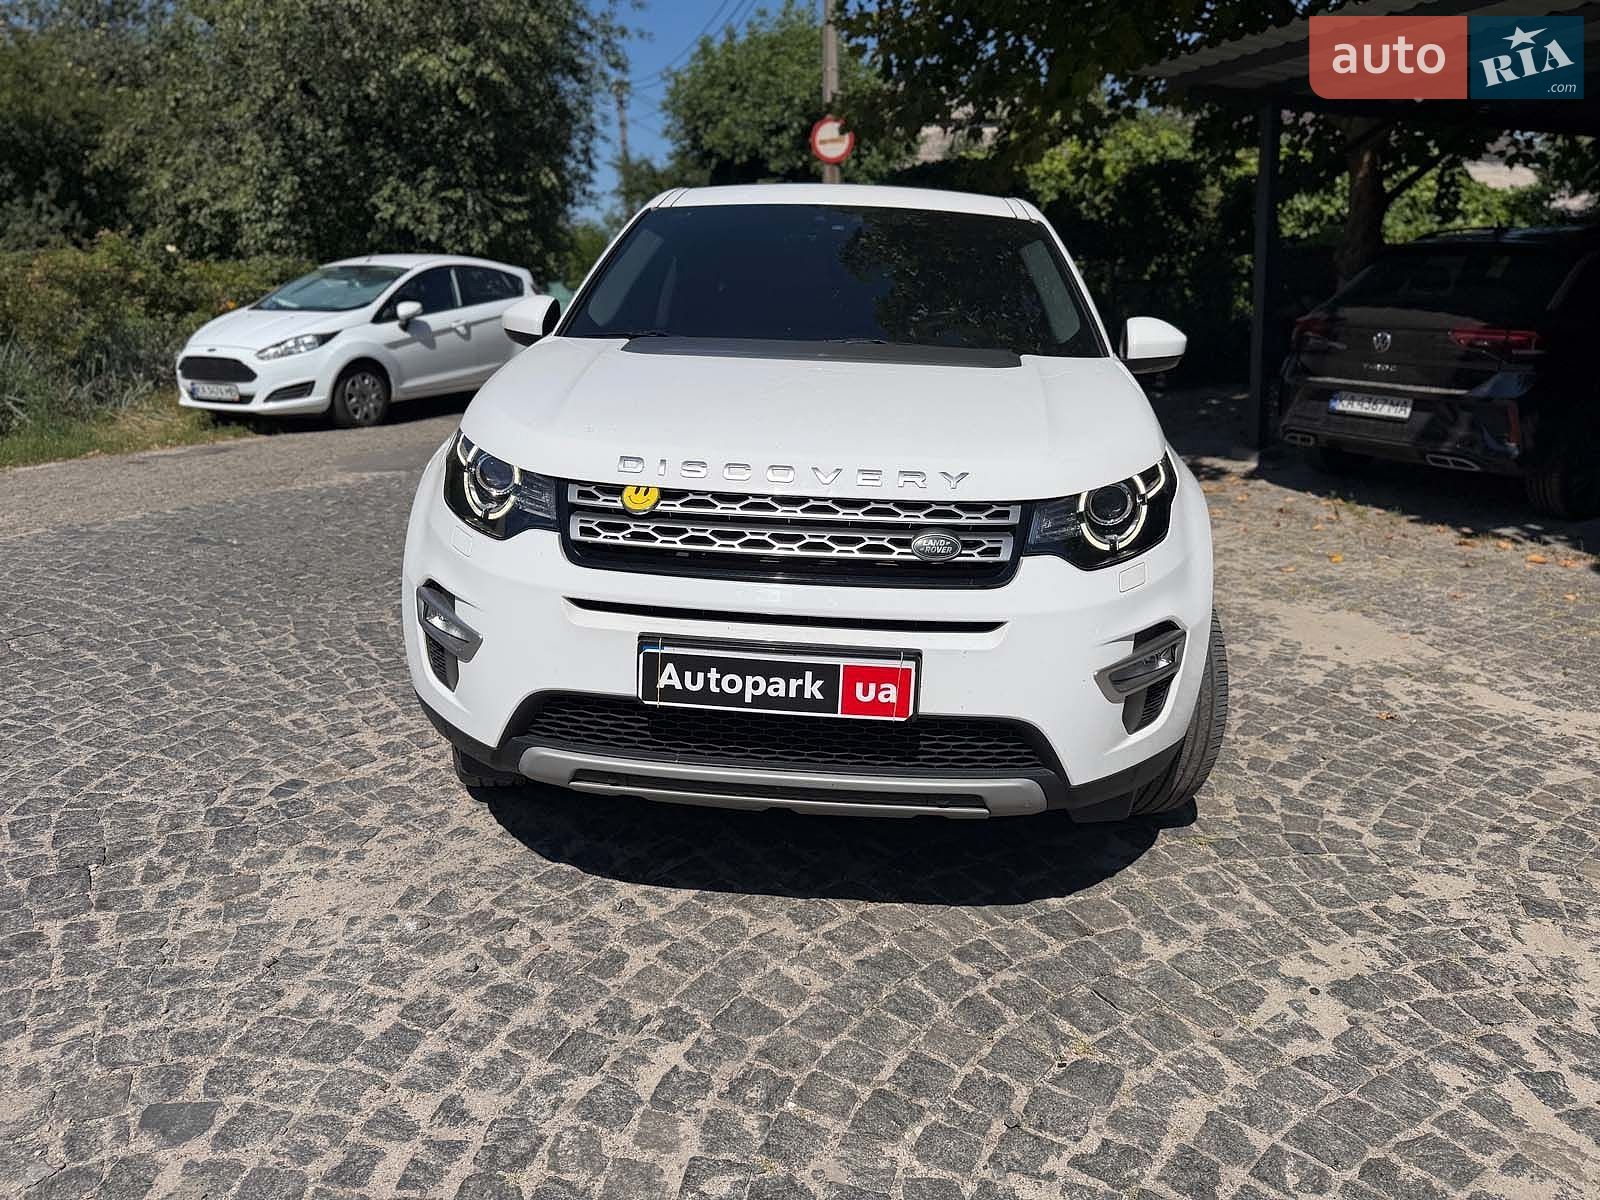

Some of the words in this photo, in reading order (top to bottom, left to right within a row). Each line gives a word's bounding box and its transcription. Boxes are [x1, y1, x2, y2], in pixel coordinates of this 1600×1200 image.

[617, 455, 970, 489] DISCOVERY
[925, 546, 953, 554] ROVER
[658, 662, 825, 703] Autopark
[854, 681, 898, 703] ua
